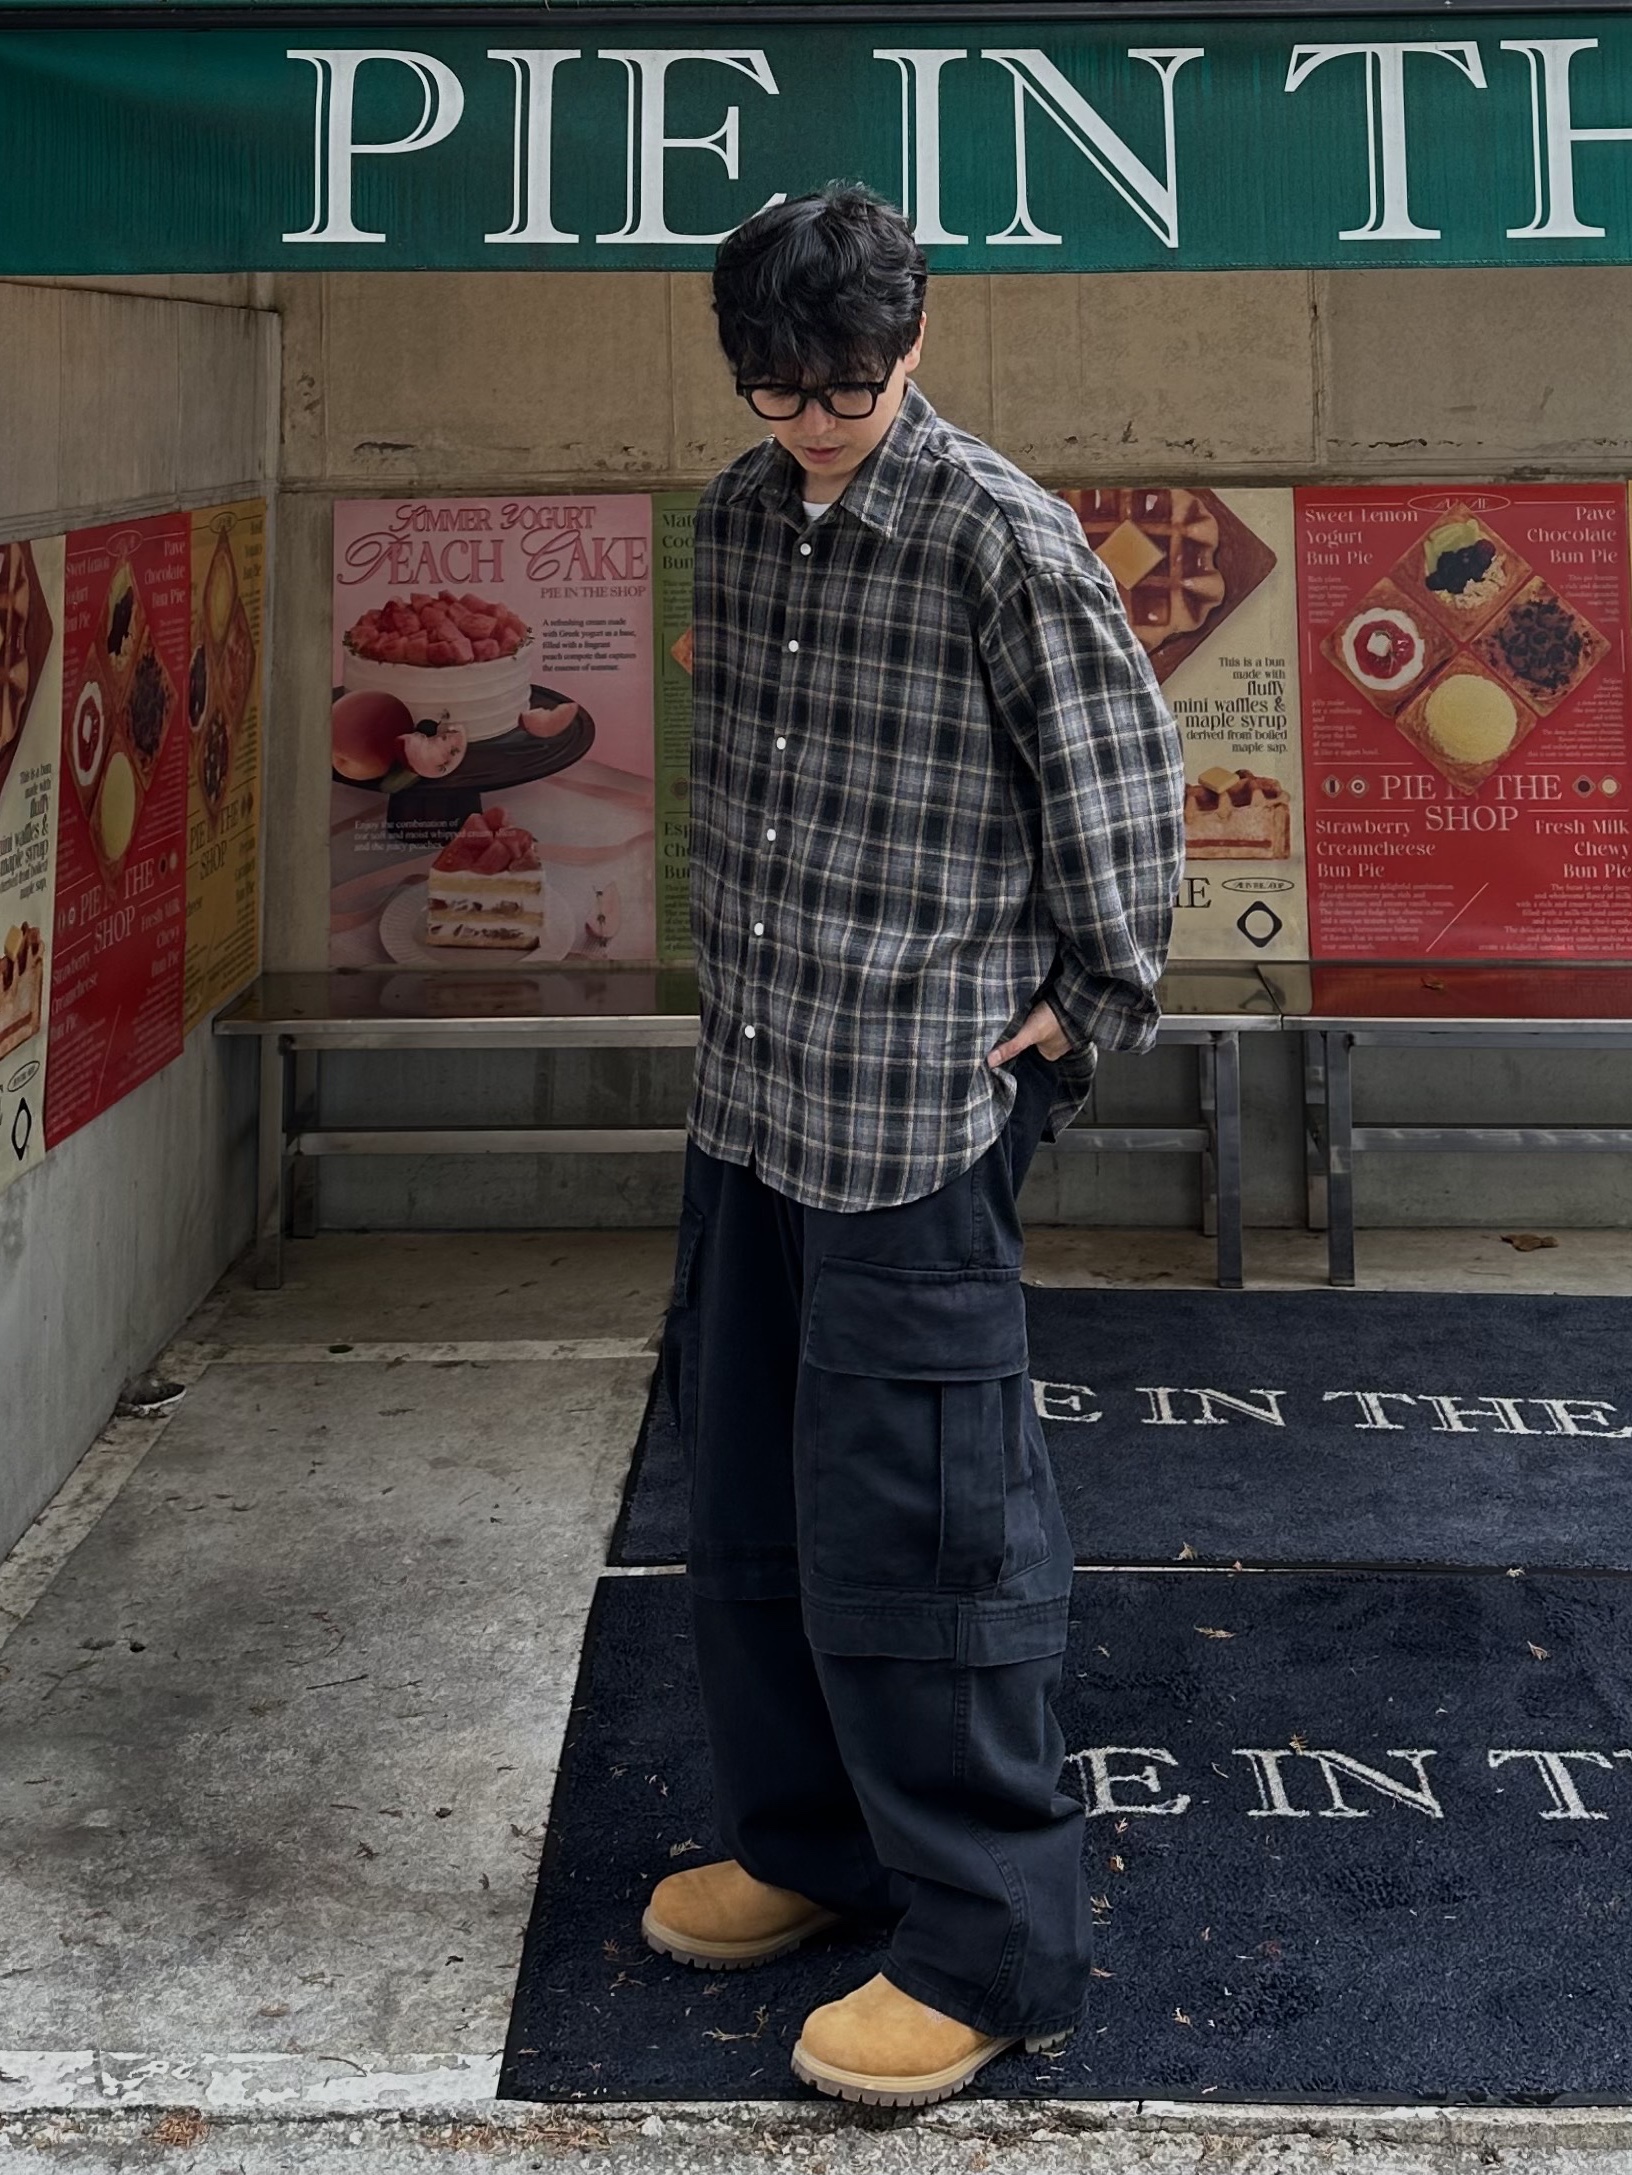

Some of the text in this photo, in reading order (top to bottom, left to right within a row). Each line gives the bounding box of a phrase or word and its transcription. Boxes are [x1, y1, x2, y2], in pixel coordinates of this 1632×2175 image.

[282, 48, 786, 246] PIE
[872, 45, 1205, 250] IN
[389, 504, 493, 532] SUMMER
[662, 512, 697, 529] Mat
[1305, 508, 1419, 523] Sweet Lemon
[1306, 530, 1363, 549] Yogurt
[1527, 528, 1617, 542] Chocolate
[337, 529, 649, 585] PEACH CAKE
[1307, 551, 1375, 566] Bun Pie
[1550, 549, 1618, 564] Bun Pie
[541, 586, 646, 599] PIE IN THE SHOP
[1218, 656, 1286, 667] This is a bun
[1233, 669, 1286, 680] made with
[1247, 680, 1284, 696] fluffy
[1173, 696, 1286, 713] mini waffles &
[1185, 712, 1287, 731] maple syrup
[1186, 729, 1288, 741] derived from boiled
[1231, 742, 1264, 754] maple
[1379, 774, 1437, 801] PIE
[1491, 774, 1563, 801] THE
[1425, 804, 1519, 832] SHOP
[1315, 819, 1411, 837] Strawberry
[1535, 819, 1631, 835] Fresh Milk
[1316, 841, 1437, 856] Creamcheese
[1574, 841, 1629, 860] Chewy
[1317, 862, 1385, 878] Bun Pie
[1563, 863, 1632, 879] Bun Pie
[80, 885, 103, 927] PIE
[123, 858, 156, 902] THE
[93, 904, 136, 954] SHOP
[1134, 1385, 1287, 1427] IN
[1321, 1390, 1632, 1440] THE
[1231, 1748, 1444, 1819] IN
